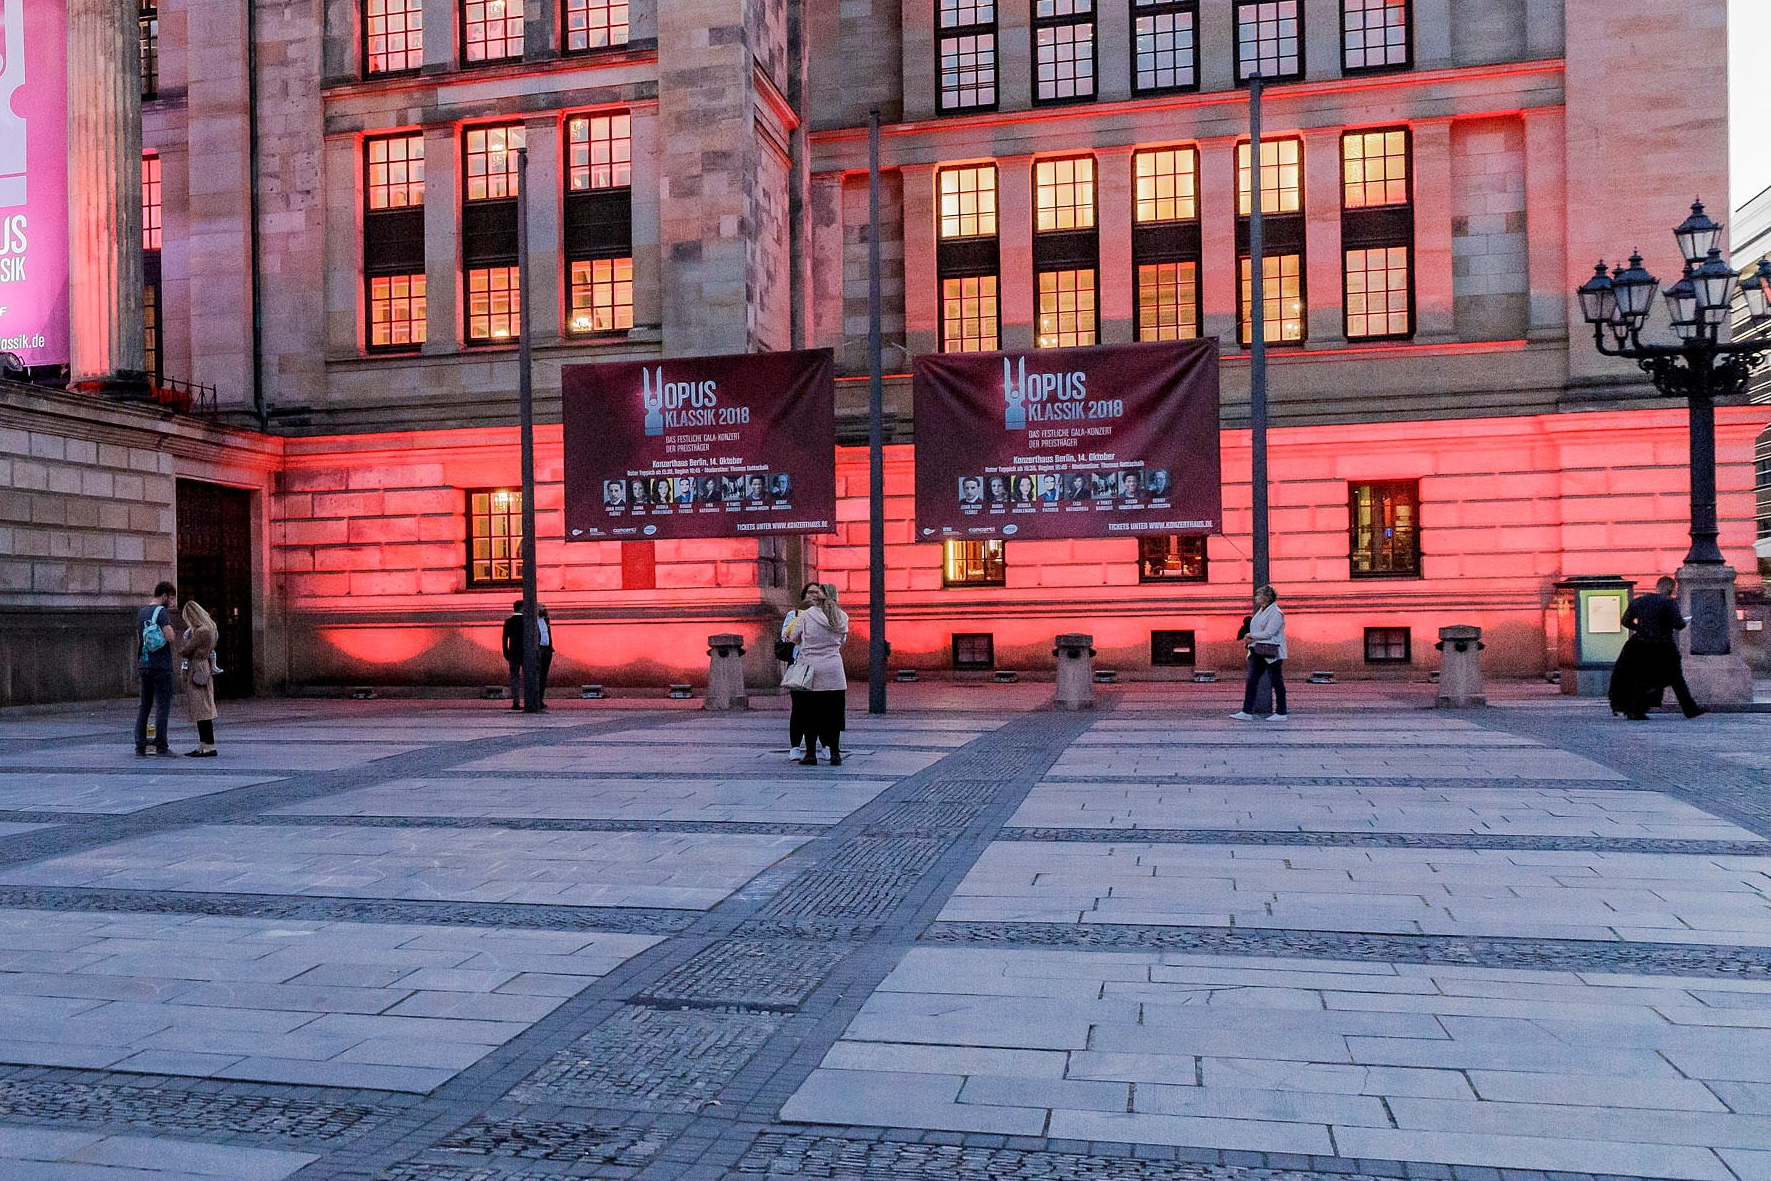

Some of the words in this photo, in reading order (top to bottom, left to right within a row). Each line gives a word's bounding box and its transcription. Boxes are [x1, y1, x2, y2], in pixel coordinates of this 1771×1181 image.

[1027, 371, 1086, 402] OPUS
[664, 380, 717, 409] OPUS
[1028, 401, 1086, 422] KLASSIK
[1088, 399, 1124, 419] 2018
[665, 409, 716, 428] KLASSIK
[719, 407, 750, 425] 2018
[665, 435, 676, 444] DAS
[677, 434, 702, 443] FESTLICHE
[703, 432, 740, 442] GALA-KONZERT
[1028, 429, 1040, 439] DAS
[1041, 428, 1070, 438] FESTLICHE
[1071, 427, 1112, 437] GALA-KONZERT
[665, 444, 676, 453] DER
[677, 443, 710, 453] PREISTRÄGER
[1028, 439, 1040, 448] DER
[652, 459, 689, 468] Konzerthaus
[689, 457, 708, 467] Berlin,
[709, 457, 718, 466] 14.
[719, 456, 743, 465] Oktober
[1013, 453, 1054, 464] Konzerthaus
[1054, 453, 1077, 464] Berlin,
[1077, 453, 1087, 462] 14.
[1088, 452, 1115, 462] Oktober
[736, 523, 755, 531] TICKETS
[755, 522, 772, 531] UNTER
[772, 520, 828, 530] WWW.KONZERTHAUS.DE
[1108, 522, 1129, 531] TICKETS
[1129, 521, 1148, 530] UNTER
[1148, 519, 1213, 529] WWW.KONZERTHAUS.DE
